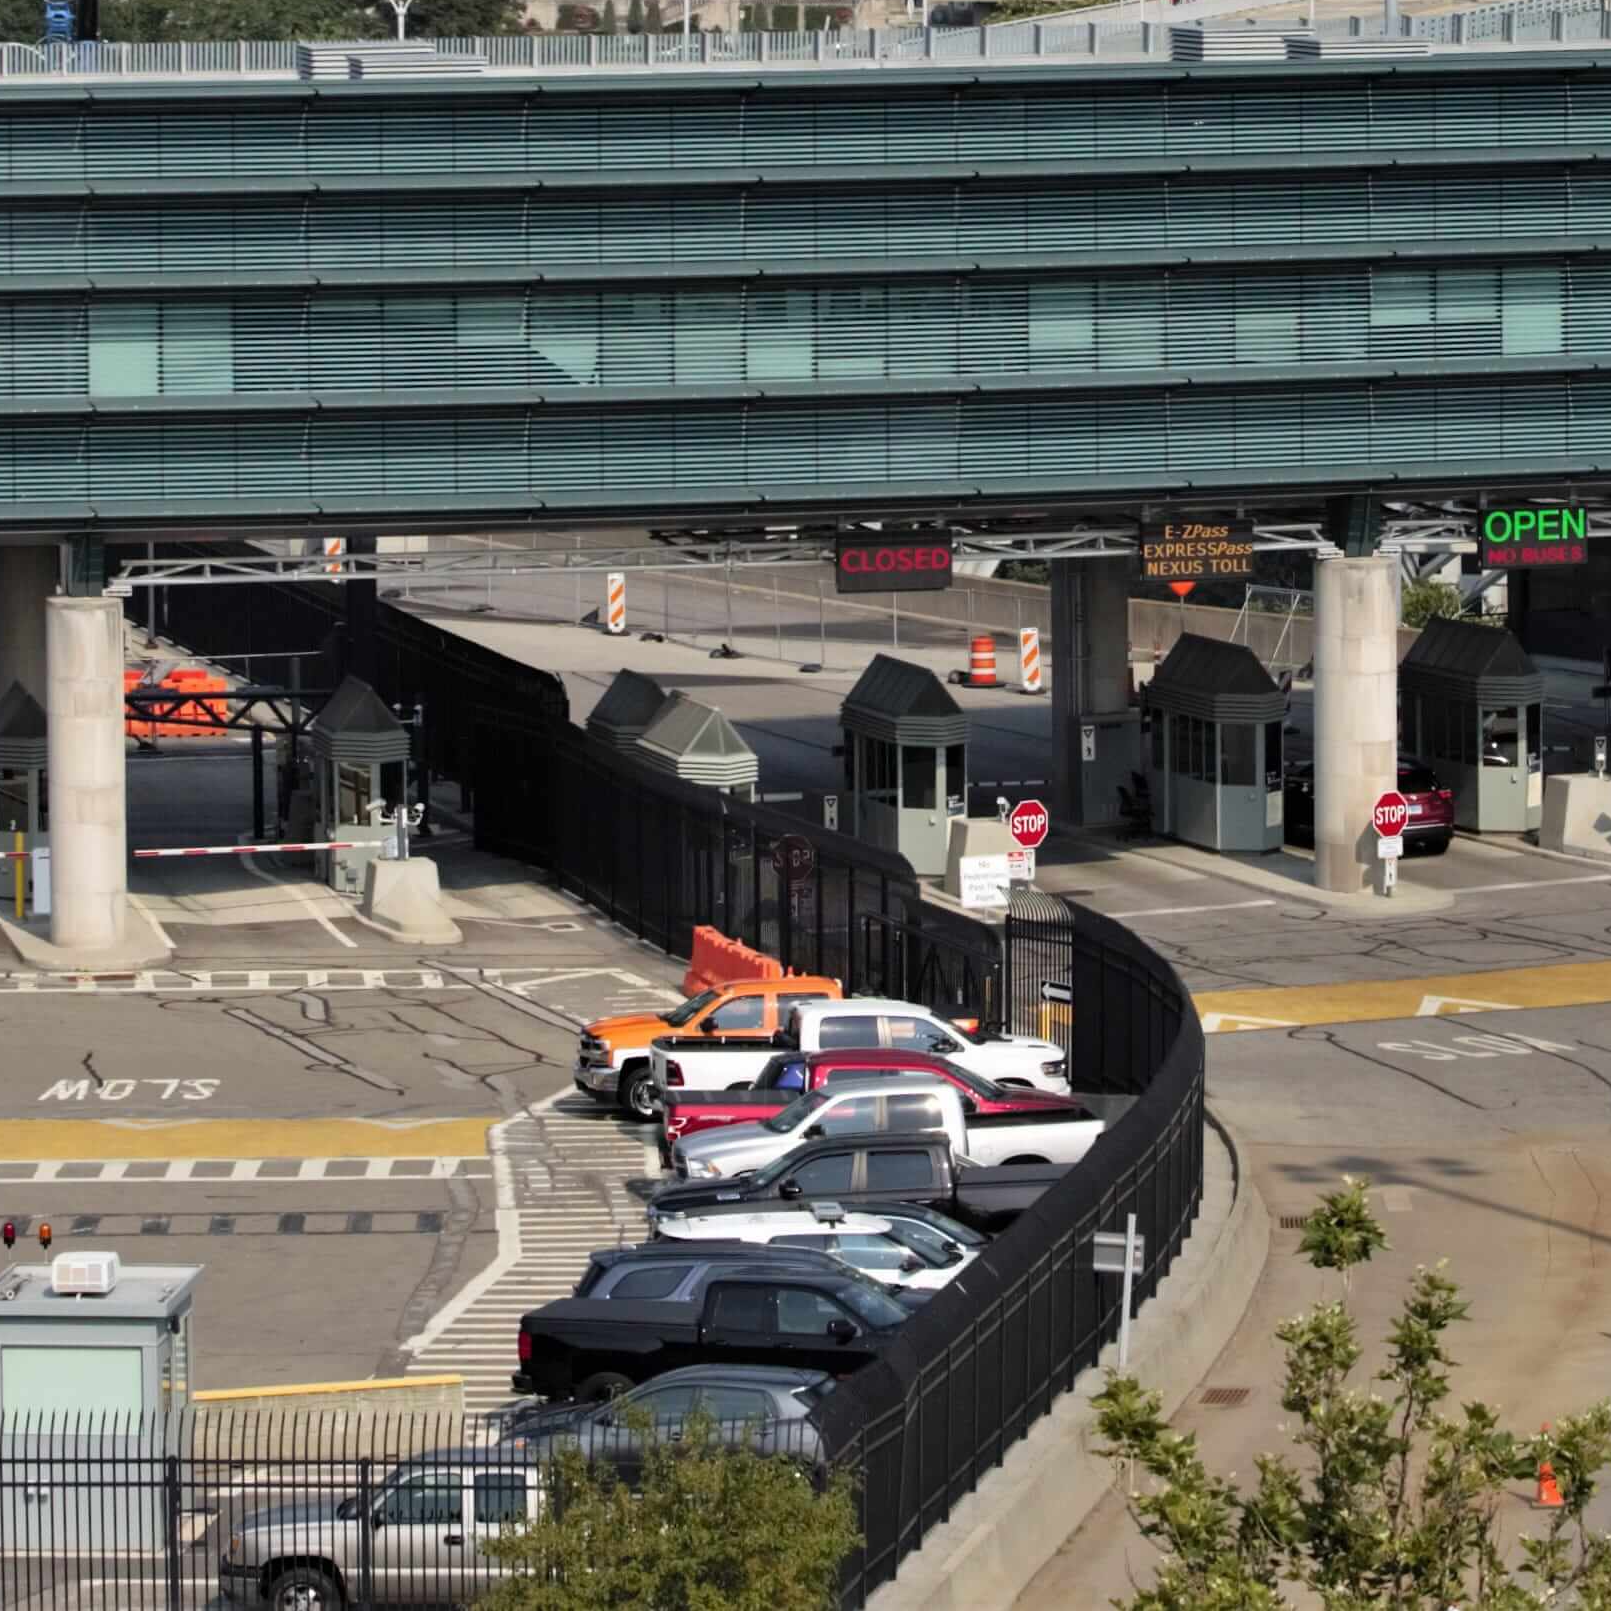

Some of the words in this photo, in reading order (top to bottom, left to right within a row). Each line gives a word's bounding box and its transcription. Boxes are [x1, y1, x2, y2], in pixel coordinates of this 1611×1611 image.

[1164, 524, 1229, 539] E-ZPass
[1485, 508, 1585, 543] OPEN
[1143, 541, 1253, 558] EXPRESSPass
[1522, 545, 1583, 564] BUSES
[840, 548, 949, 573] CLOSED
[1147, 560, 1205, 575] NEXUS
[1210, 558, 1252, 573] TOLL
[1014, 814, 1044, 834] STOP
[1376, 805, 1405, 824] STOP
